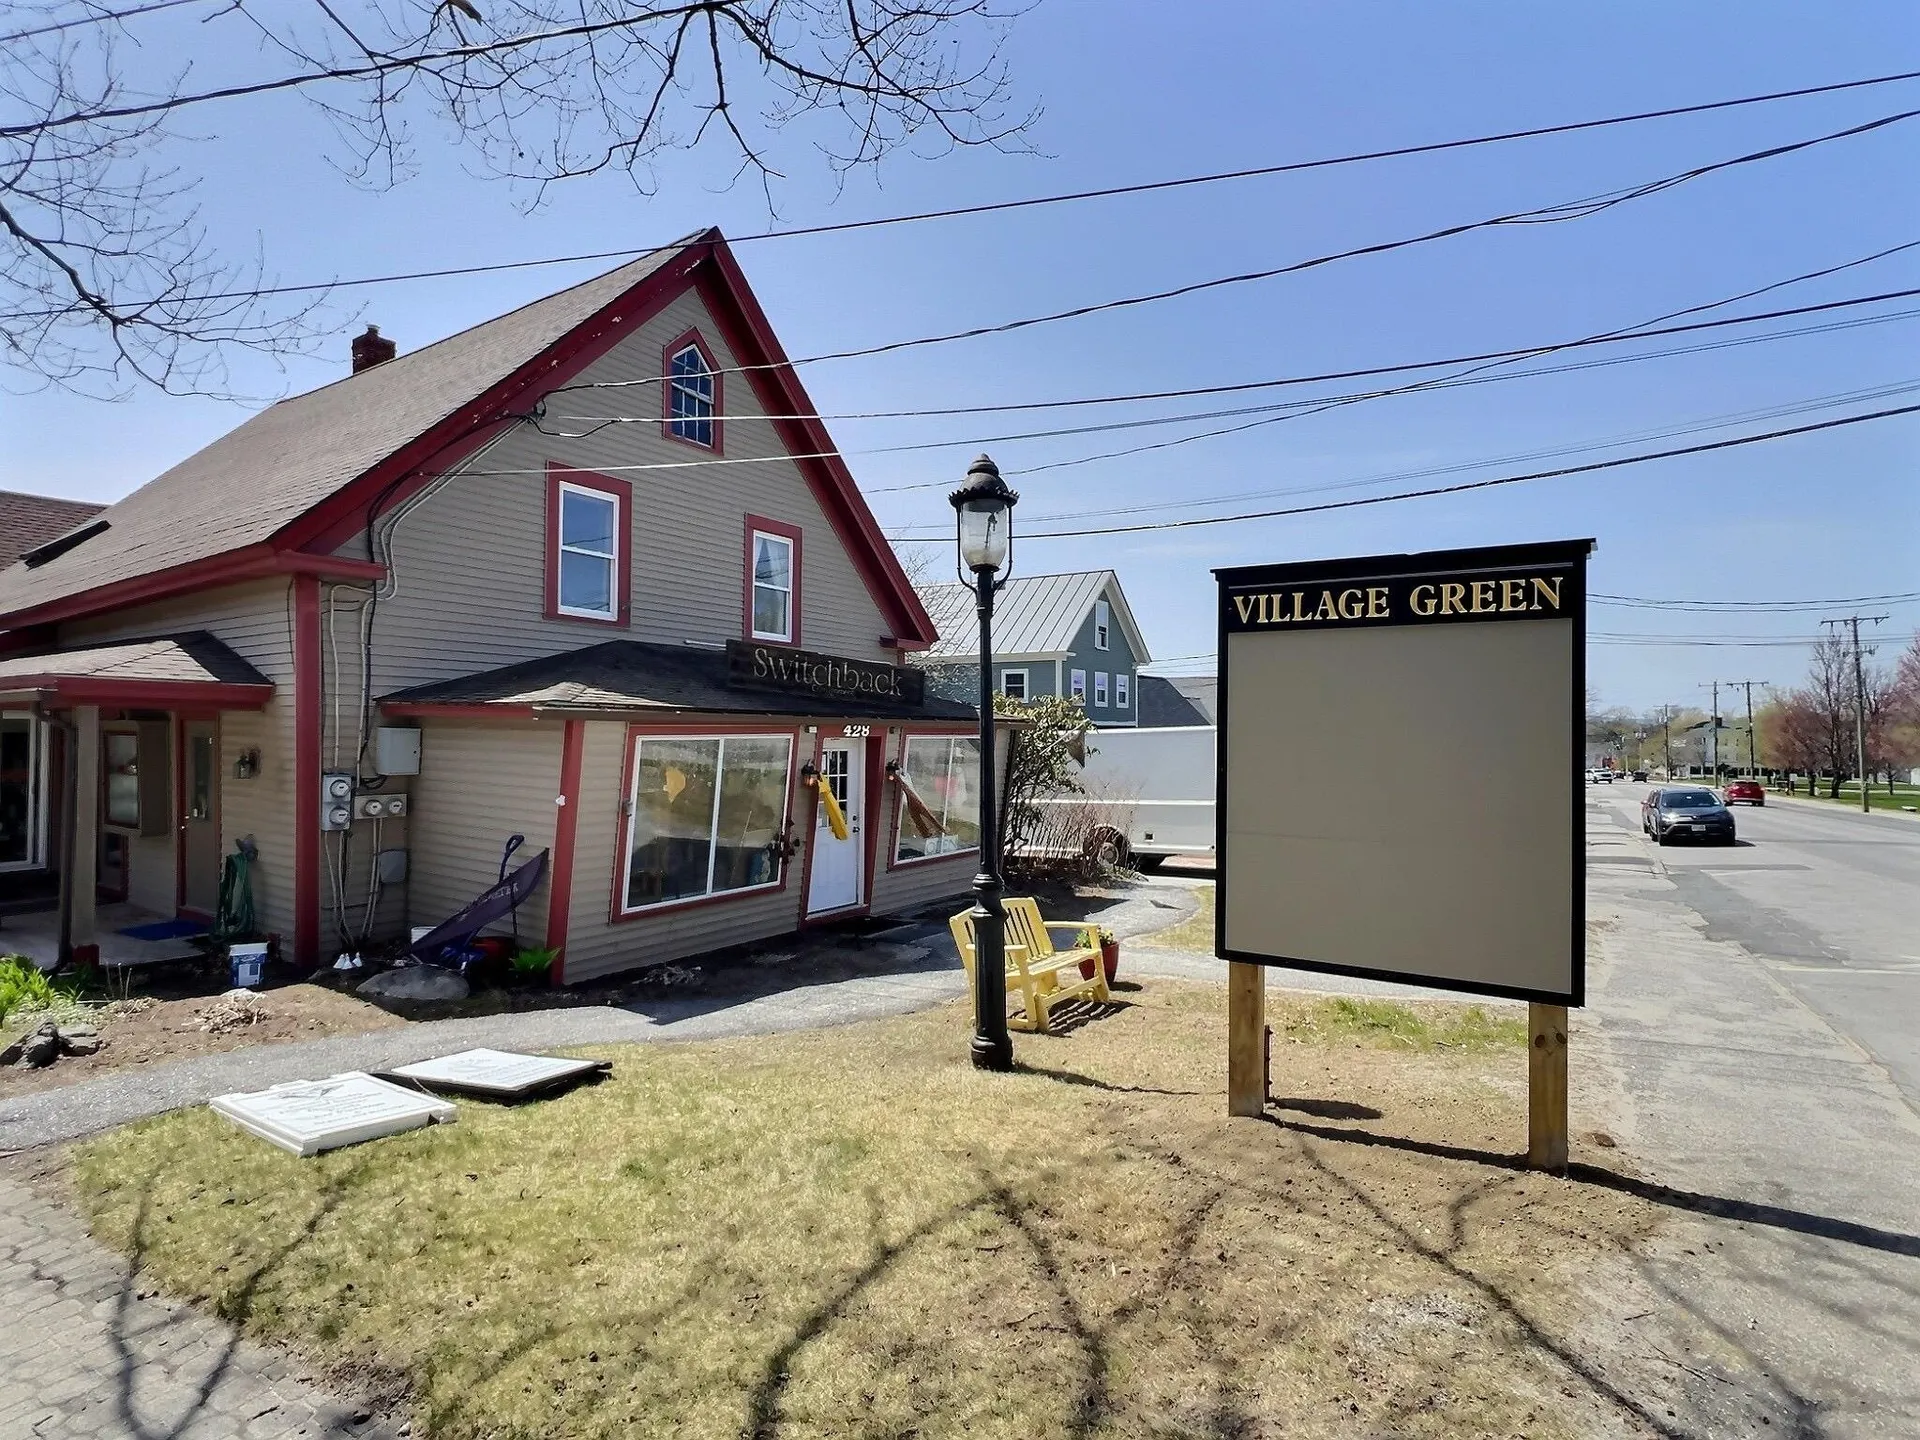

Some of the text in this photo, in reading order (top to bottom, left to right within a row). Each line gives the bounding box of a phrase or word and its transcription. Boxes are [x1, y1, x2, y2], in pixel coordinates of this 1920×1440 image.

[1233, 576, 1564, 624] VILLAGE GREEN
[752, 647, 902, 697] Switchback
[843, 725, 870, 737] 428
